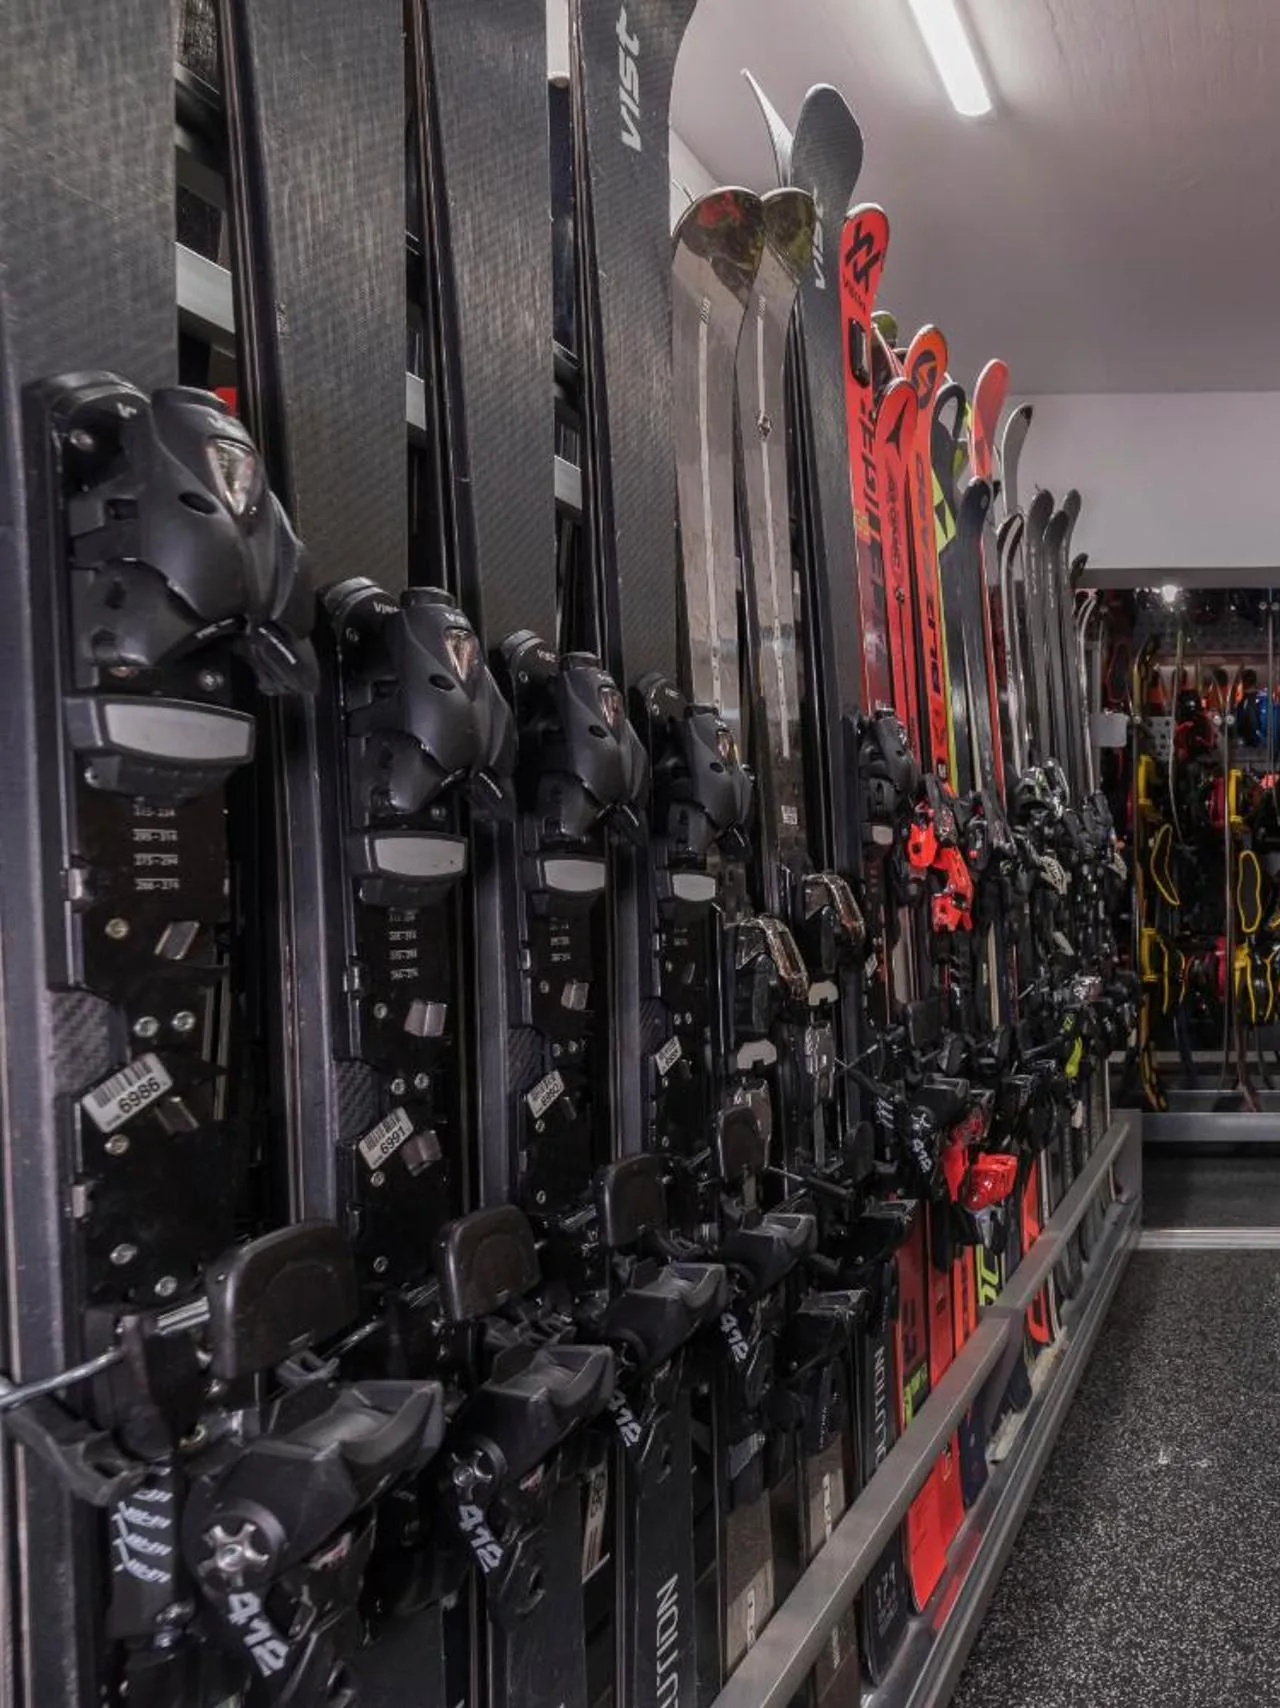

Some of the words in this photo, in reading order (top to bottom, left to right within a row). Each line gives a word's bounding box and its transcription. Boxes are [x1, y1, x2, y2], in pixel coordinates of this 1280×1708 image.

[118, 1076, 160, 1114] 6986
[380, 1126, 405, 1154] 6991
[459, 1504, 505, 1574] 412
[228, 1591, 290, 1677] 412
